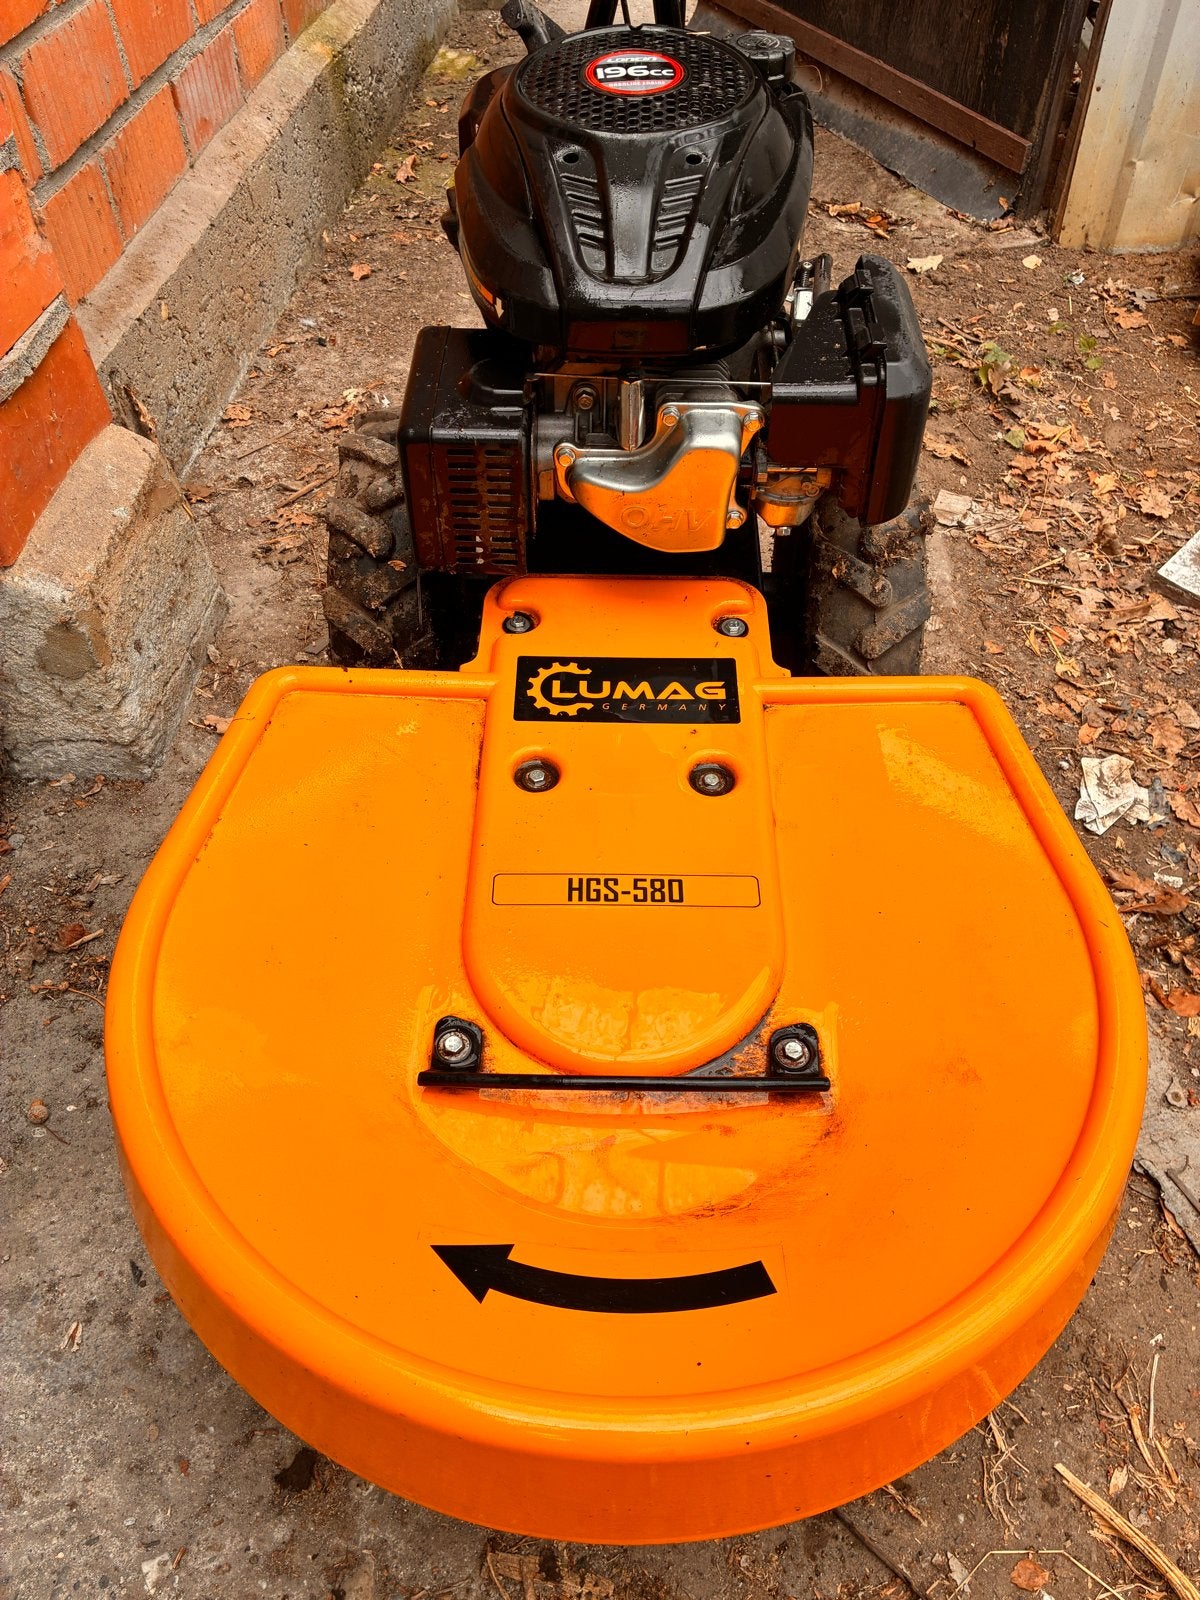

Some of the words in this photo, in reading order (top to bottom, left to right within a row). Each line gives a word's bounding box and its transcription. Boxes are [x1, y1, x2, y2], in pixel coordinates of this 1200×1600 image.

[596, 65, 675, 80] 196cc
[551, 679, 726, 700] LUMAG
[602, 702, 726, 711] GERMANY
[567, 877, 684, 903] HGS-580
